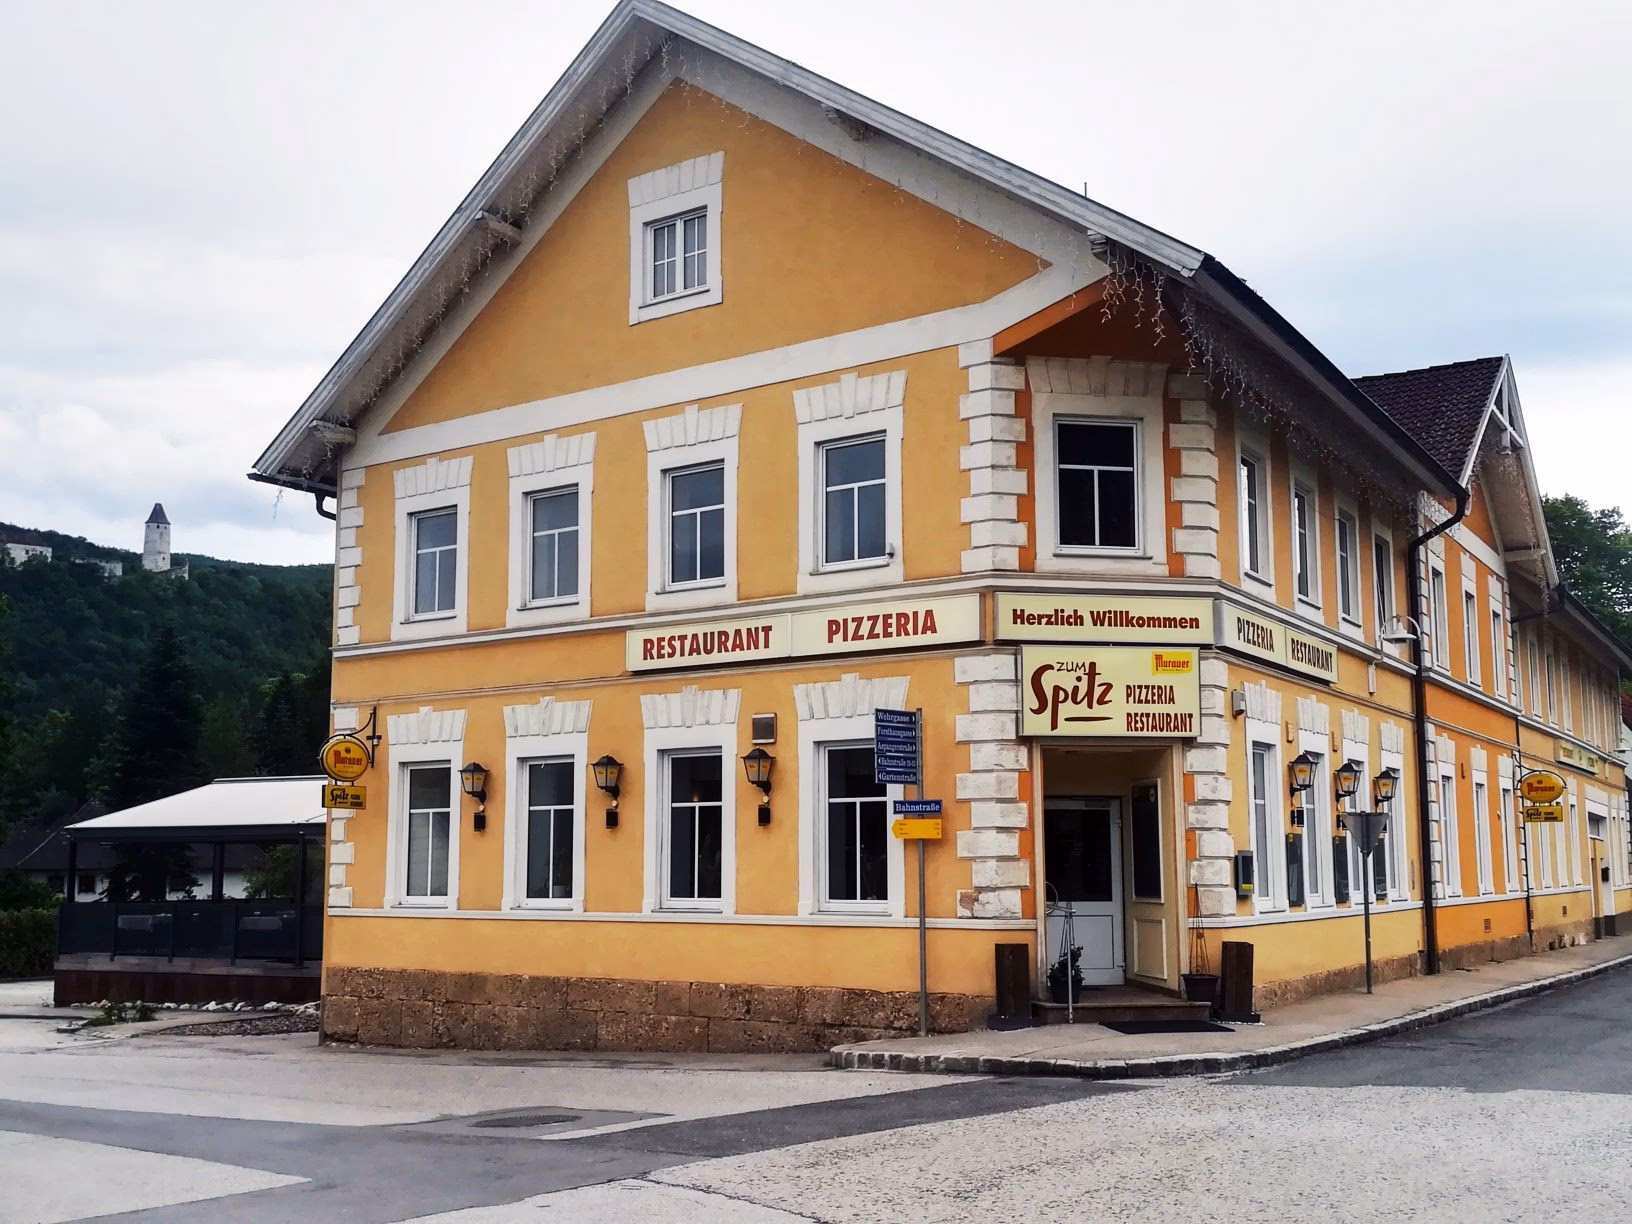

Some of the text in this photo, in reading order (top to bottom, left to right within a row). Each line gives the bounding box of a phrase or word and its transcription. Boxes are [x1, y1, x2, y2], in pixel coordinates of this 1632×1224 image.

[1012, 608, 1200, 629] Herzlich Willkommen
[643, 609, 937, 661] RESTAURANT PIZZERIA
[1237, 617, 1333, 673] PIZZERIA RESTAURANT
[1154, 654, 1190, 672] Murauer
[1029, 661, 1114, 732] Spitz
[1125, 684, 1176, 705] PIZZERIA
[877, 711, 910, 723] Wehrgasse
[1126, 712, 1194, 733] RESTAURANT
[881, 772, 916, 782] Gartenstraße
[895, 803, 940, 811] Bahnstraße
